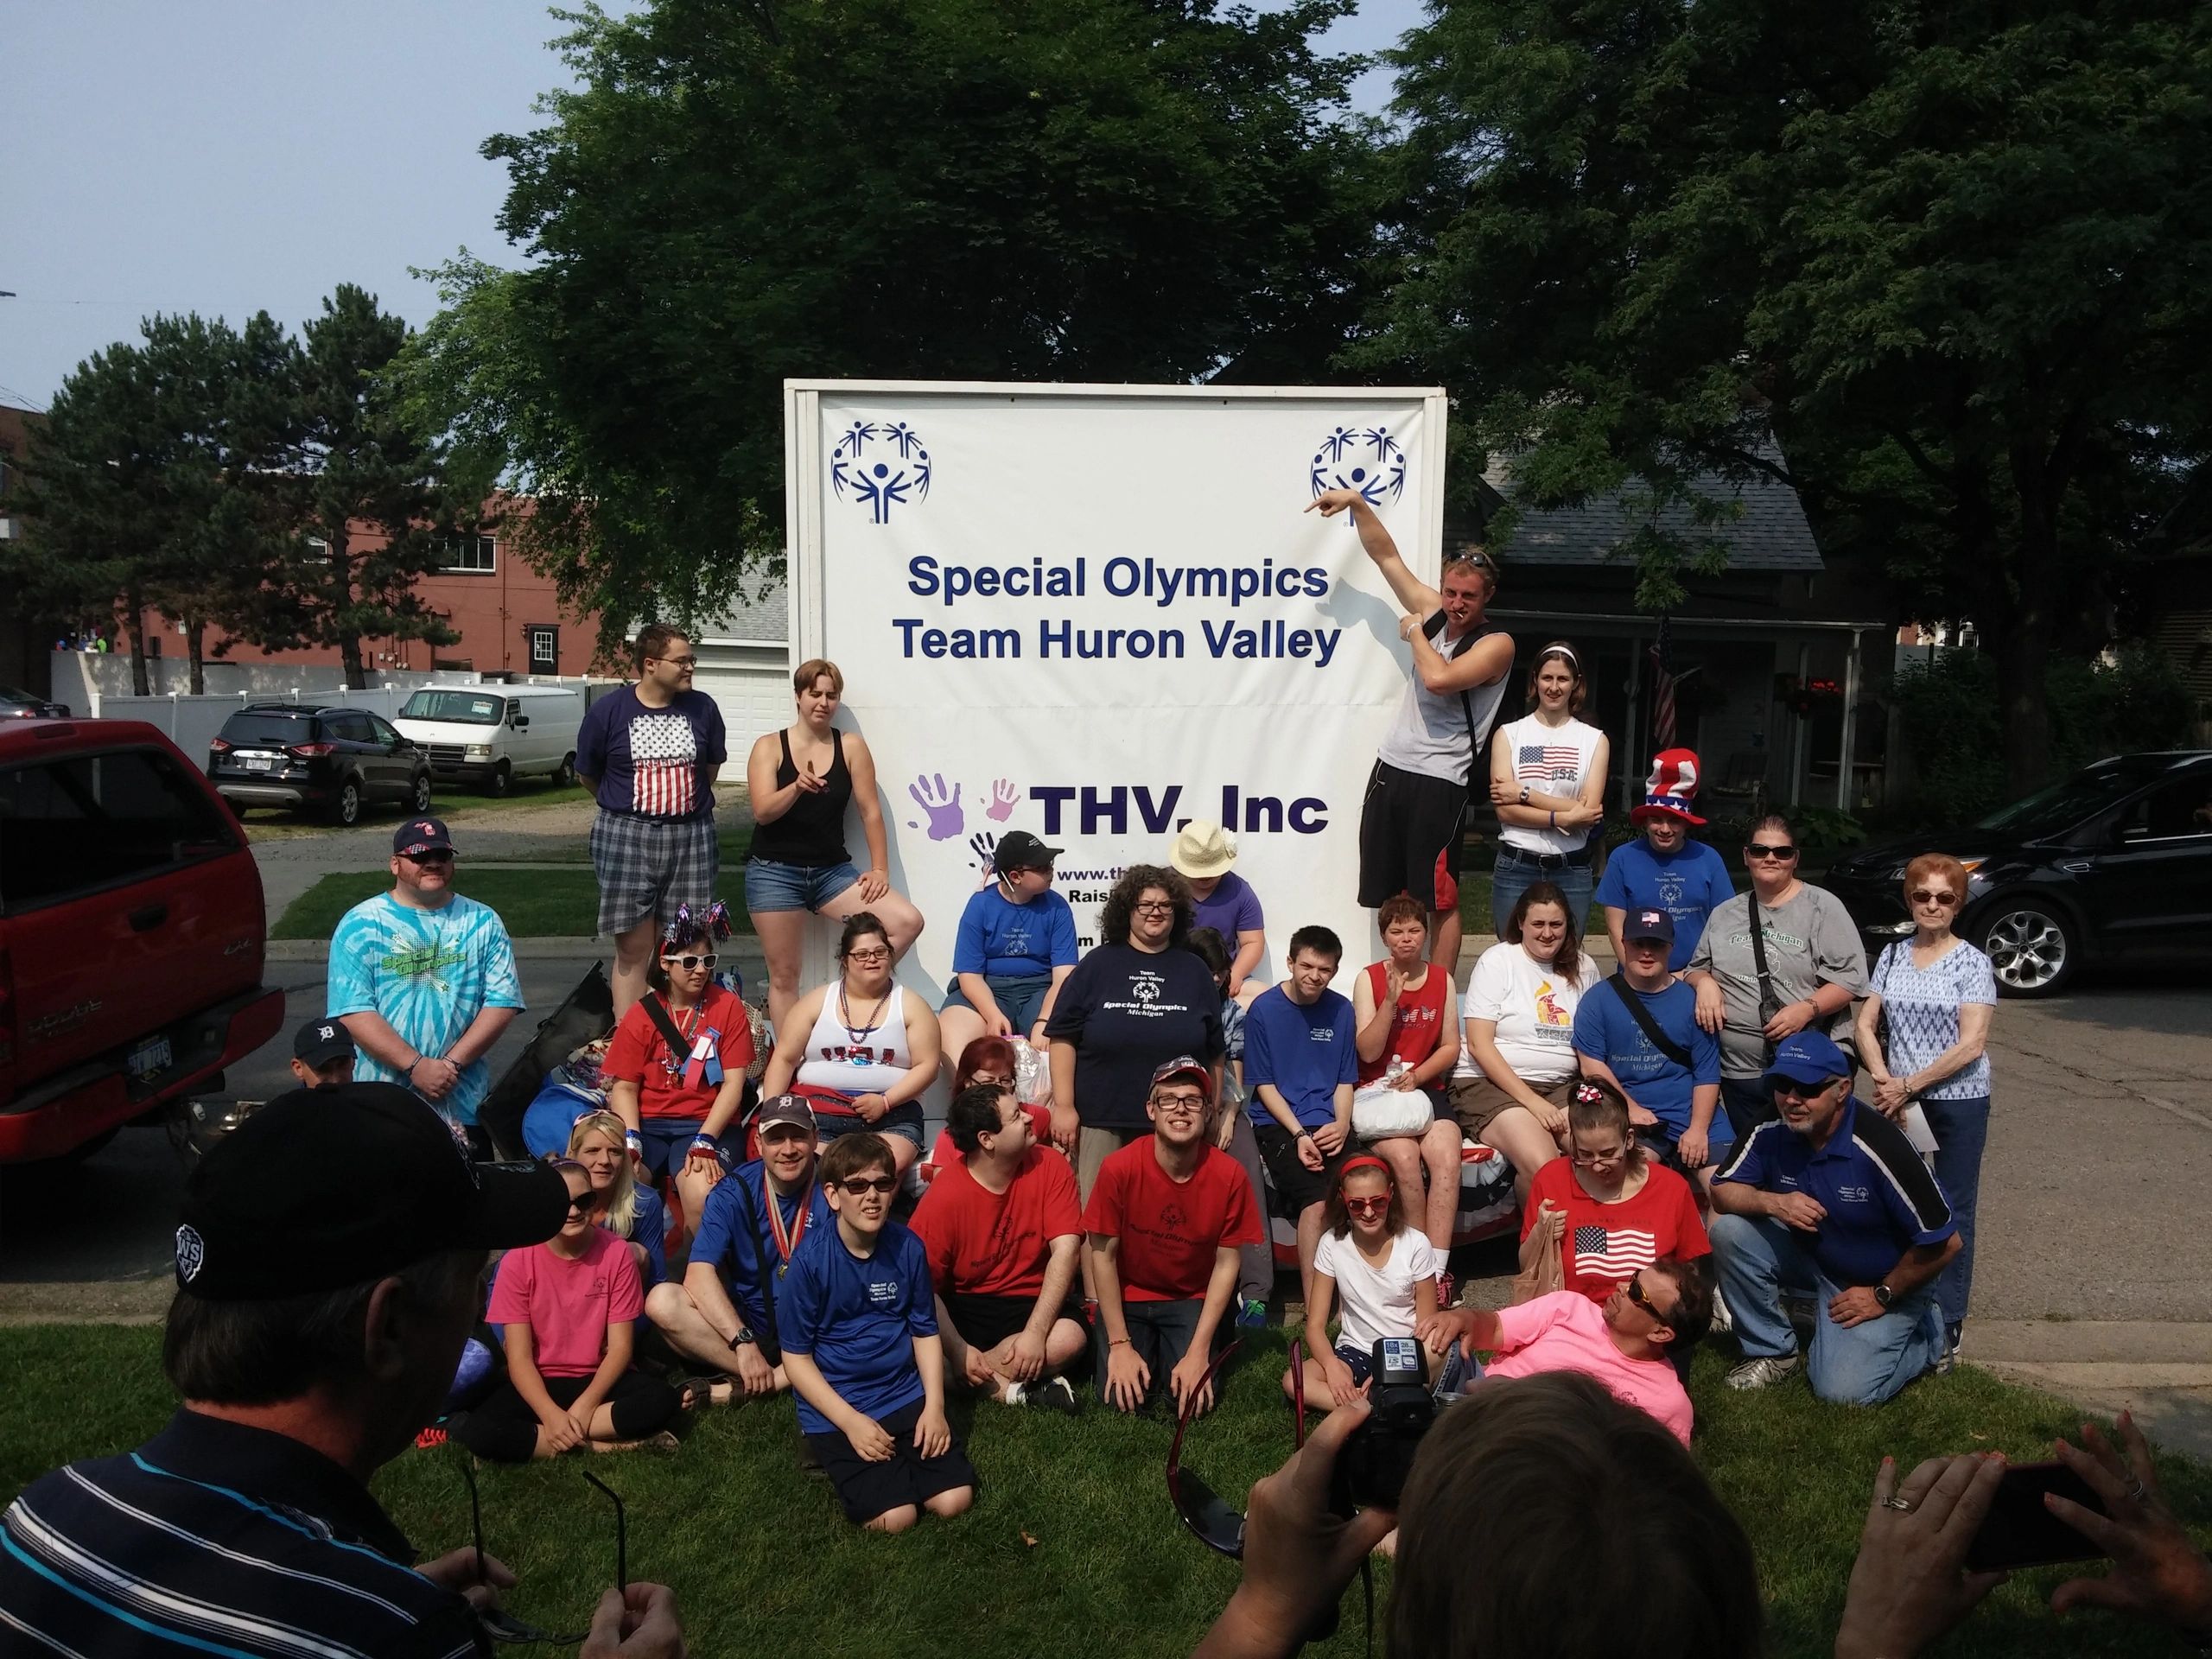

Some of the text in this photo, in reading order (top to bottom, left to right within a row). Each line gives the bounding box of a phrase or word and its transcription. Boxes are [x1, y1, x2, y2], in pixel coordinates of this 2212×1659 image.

[907, 555, 1329, 607] Special Olympics
[892, 619, 1342, 668] Team Huron Valley
[1221, 785, 1330, 835] Inc
[382, 944, 439, 969] Special
[397, 952, 467, 976] Olympics
[1103, 1001, 1188, 1012] Special Olympics
[1127, 1009, 1164, 1018] Michigan
[177, 1236, 200, 1262] WS
